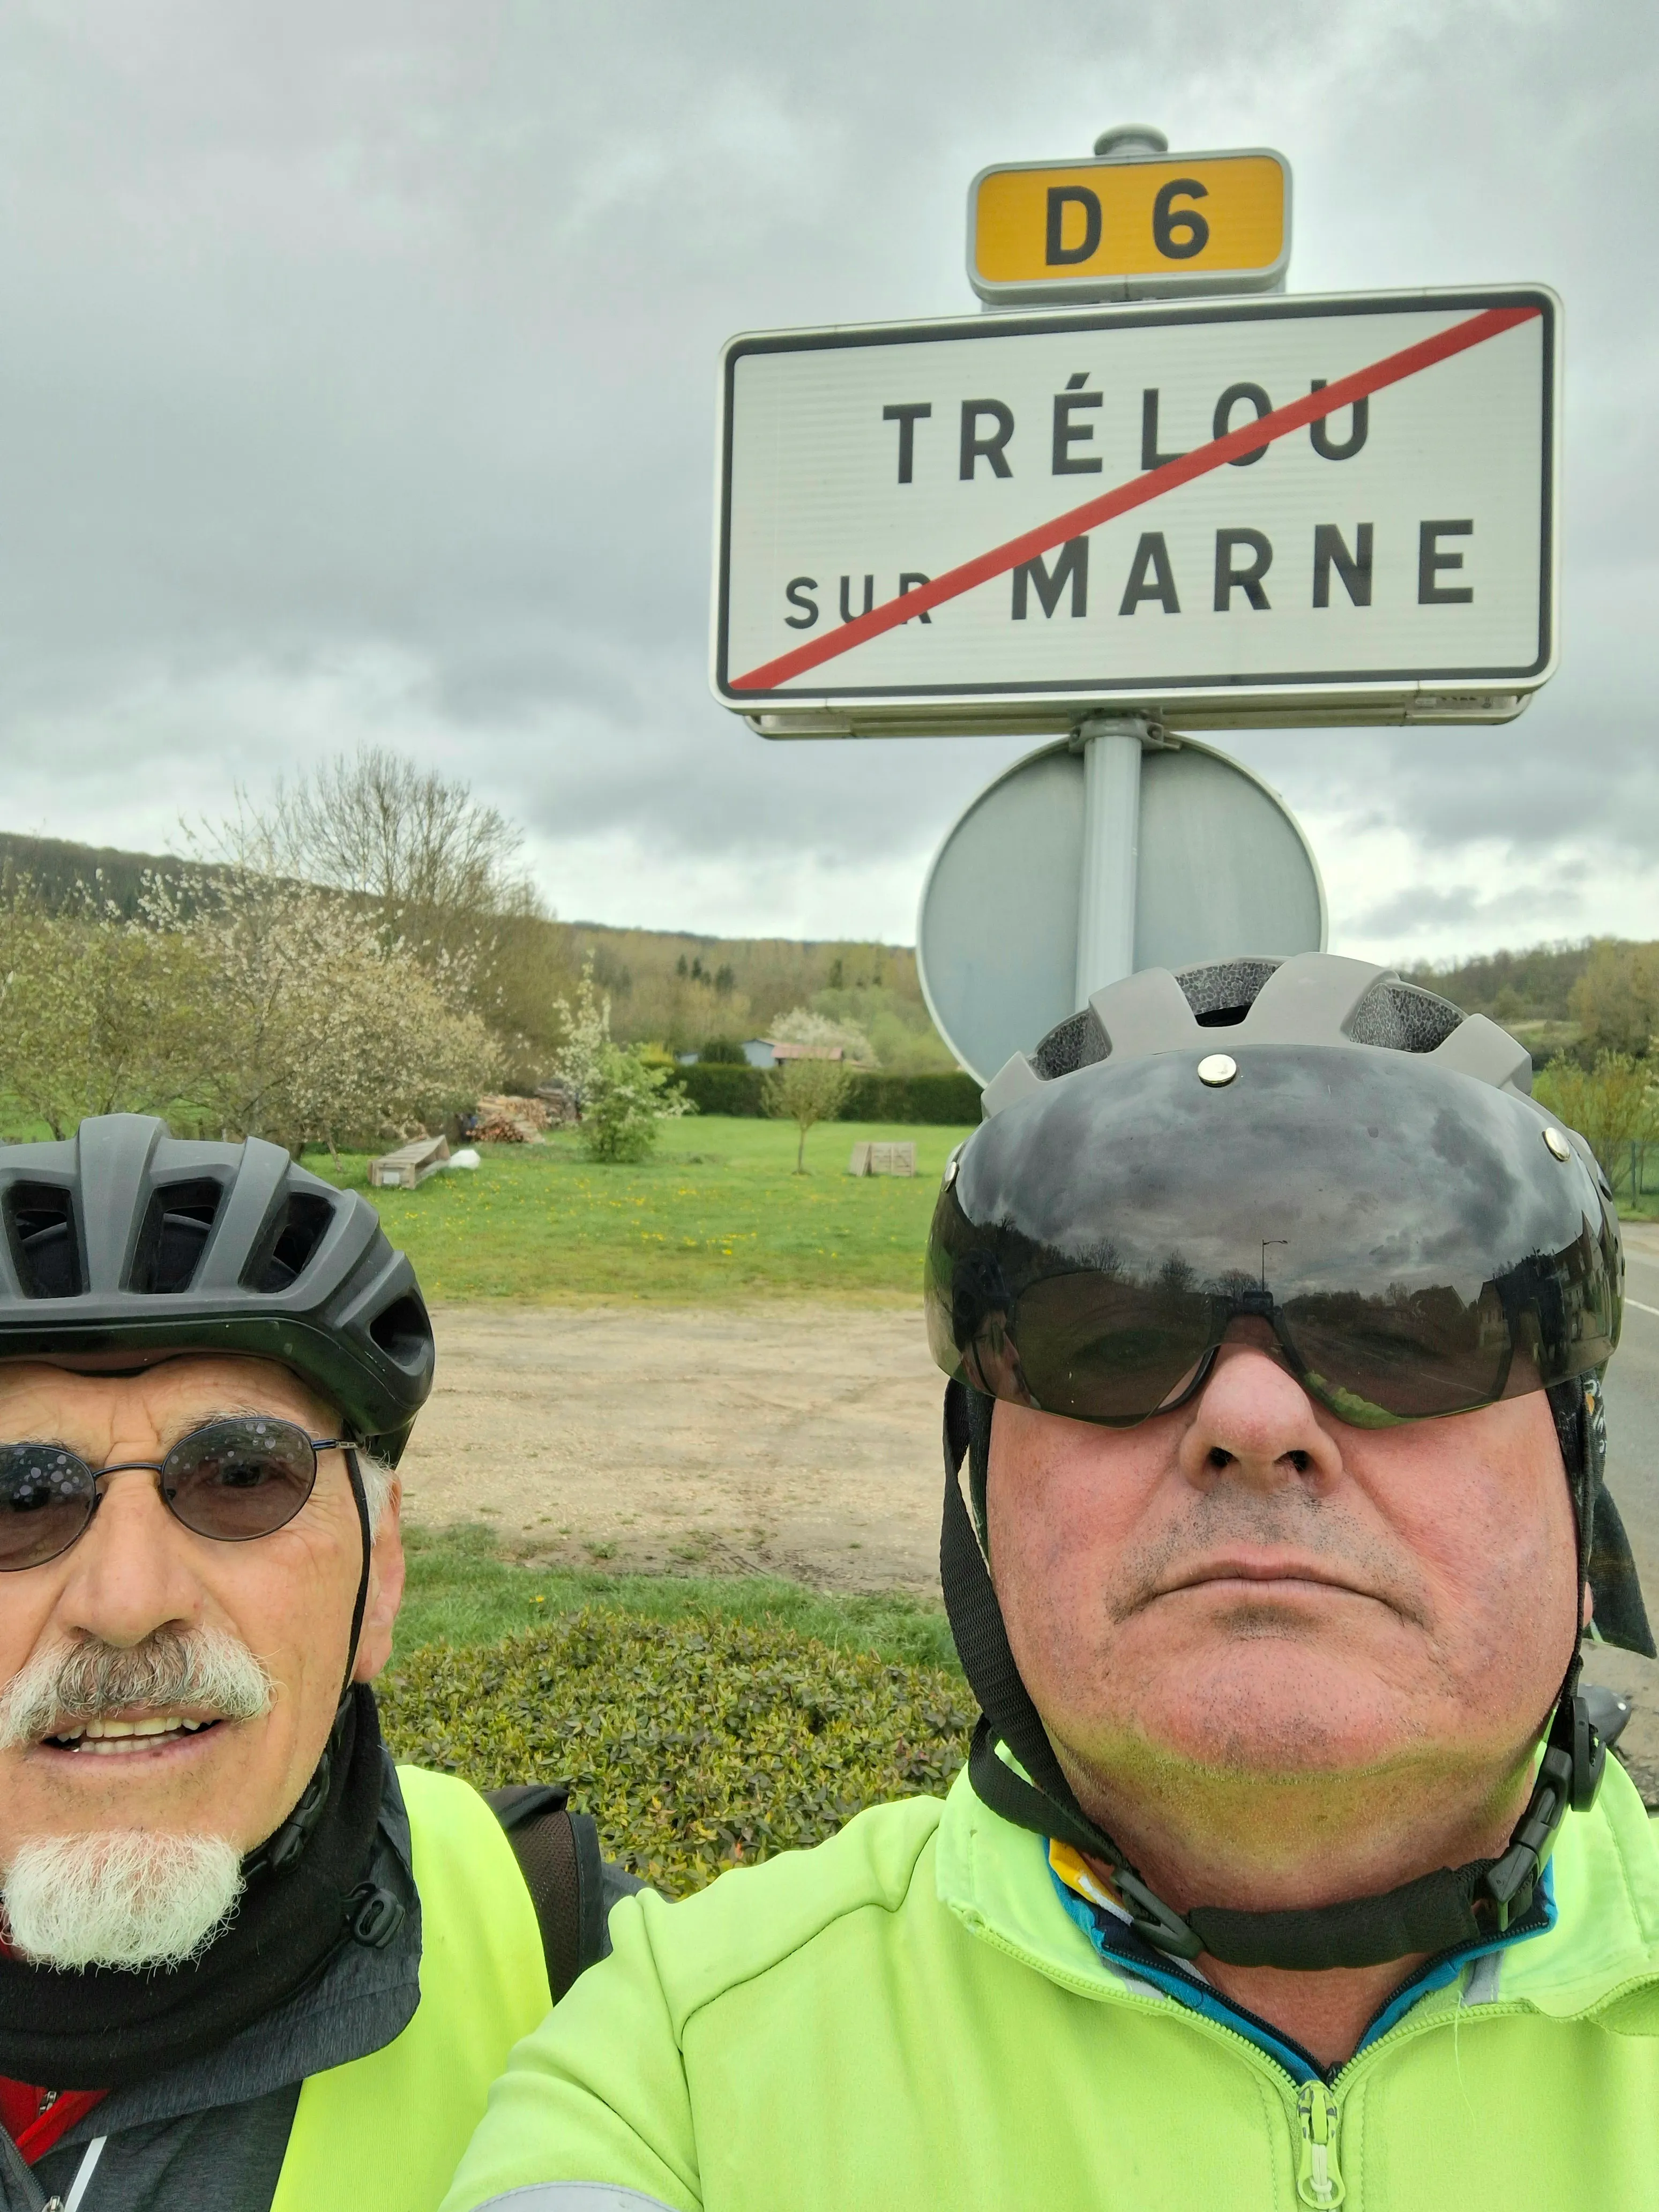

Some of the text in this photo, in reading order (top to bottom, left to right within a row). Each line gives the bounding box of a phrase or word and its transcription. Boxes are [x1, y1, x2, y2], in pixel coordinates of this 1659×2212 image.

[1045, 178, 1209, 266] D 6
[883, 372, 1369, 484] TRÉLOU
[784, 519, 1474, 630] SUR MARNE
